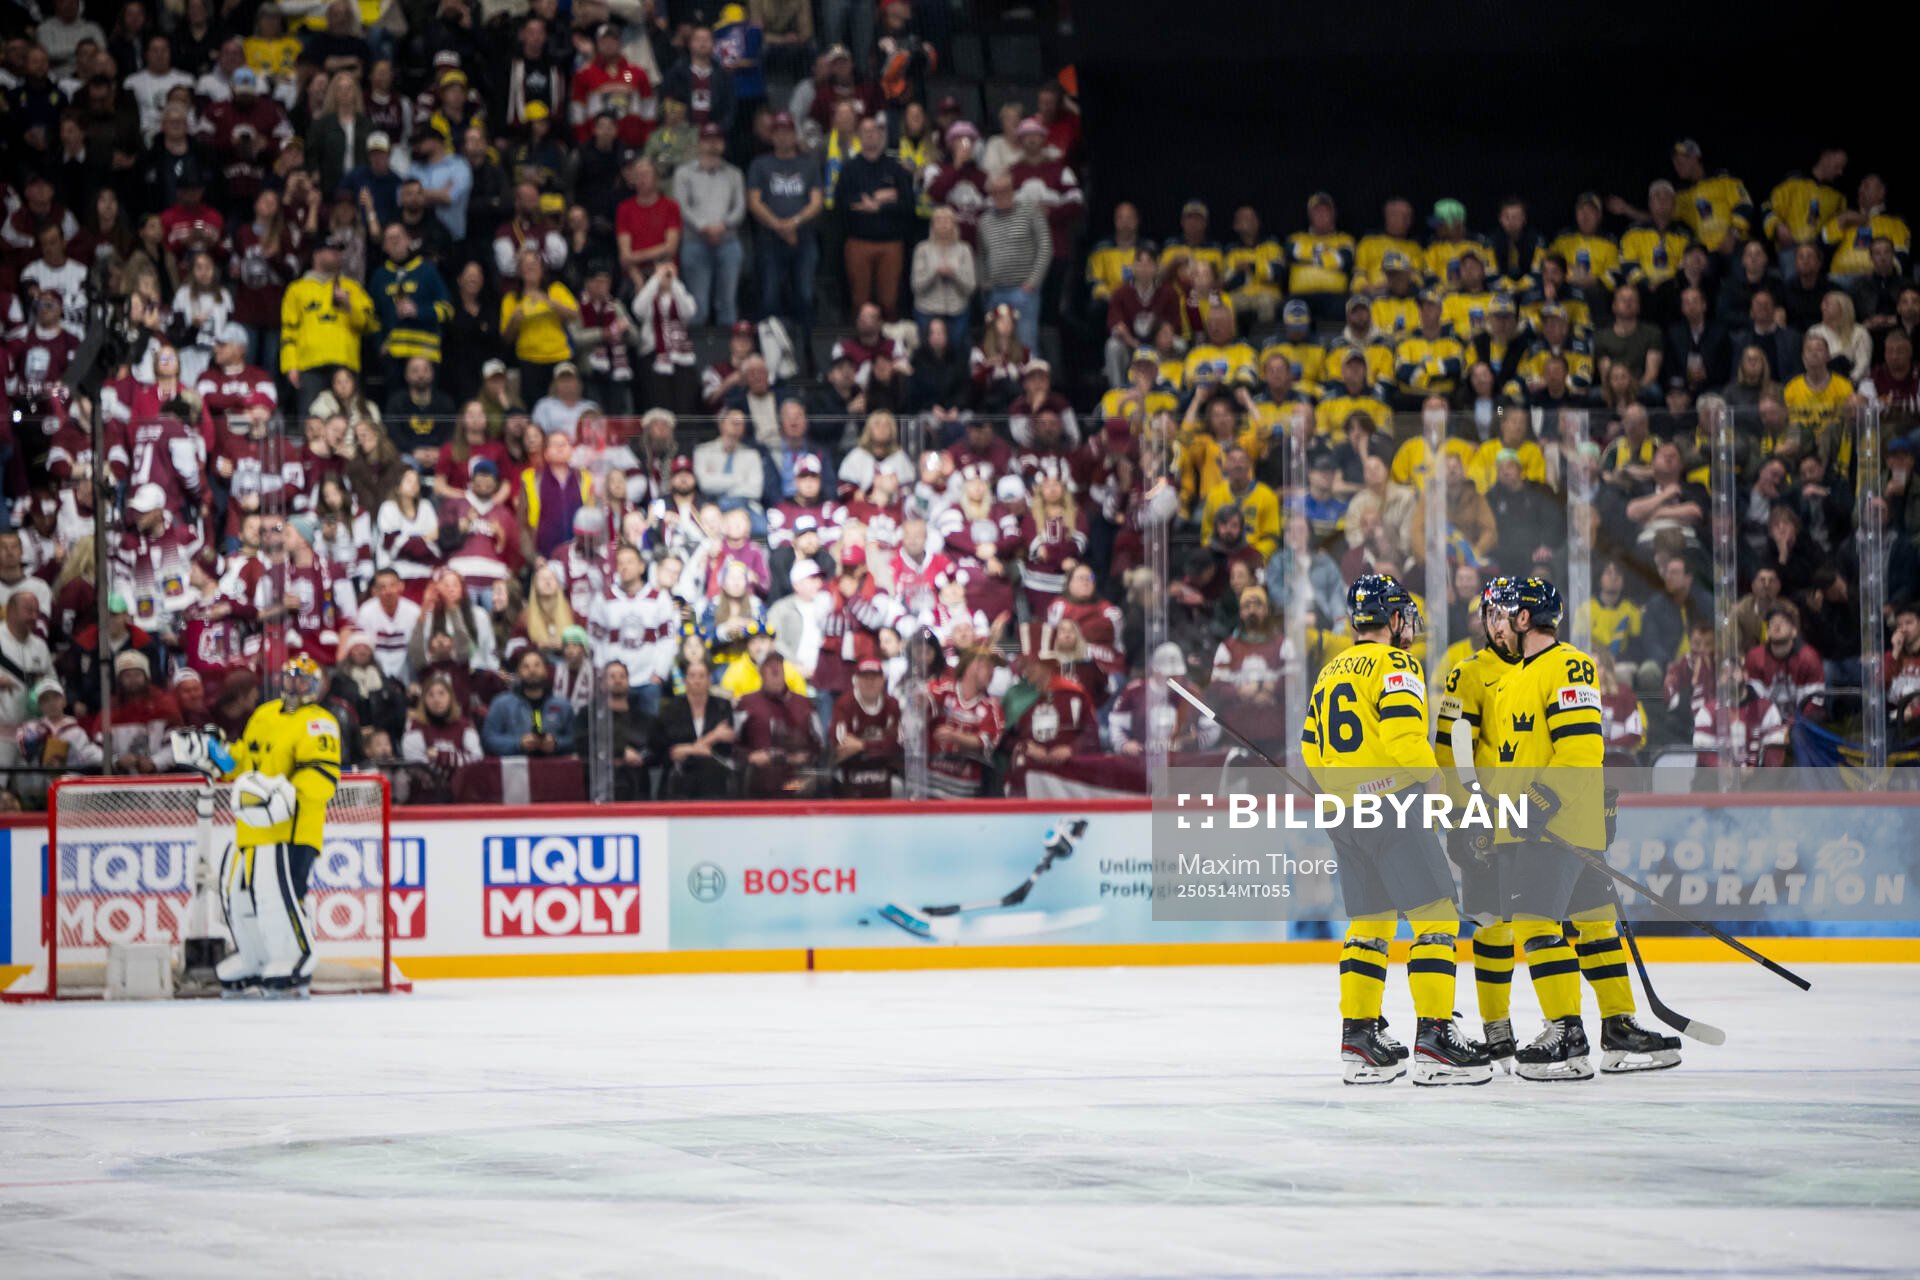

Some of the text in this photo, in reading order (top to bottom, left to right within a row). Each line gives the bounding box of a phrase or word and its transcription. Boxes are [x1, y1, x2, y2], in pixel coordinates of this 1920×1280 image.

[1388, 651, 1419, 675] 56
[1565, 659, 1595, 685] 28
[308, 838, 420, 888] QUI
[489, 837, 635, 885] LIQUI
[1608, 837, 1798, 871] SPORTS
[744, 867, 857, 895] BOSCH
[489, 886, 639, 936] MOLY
